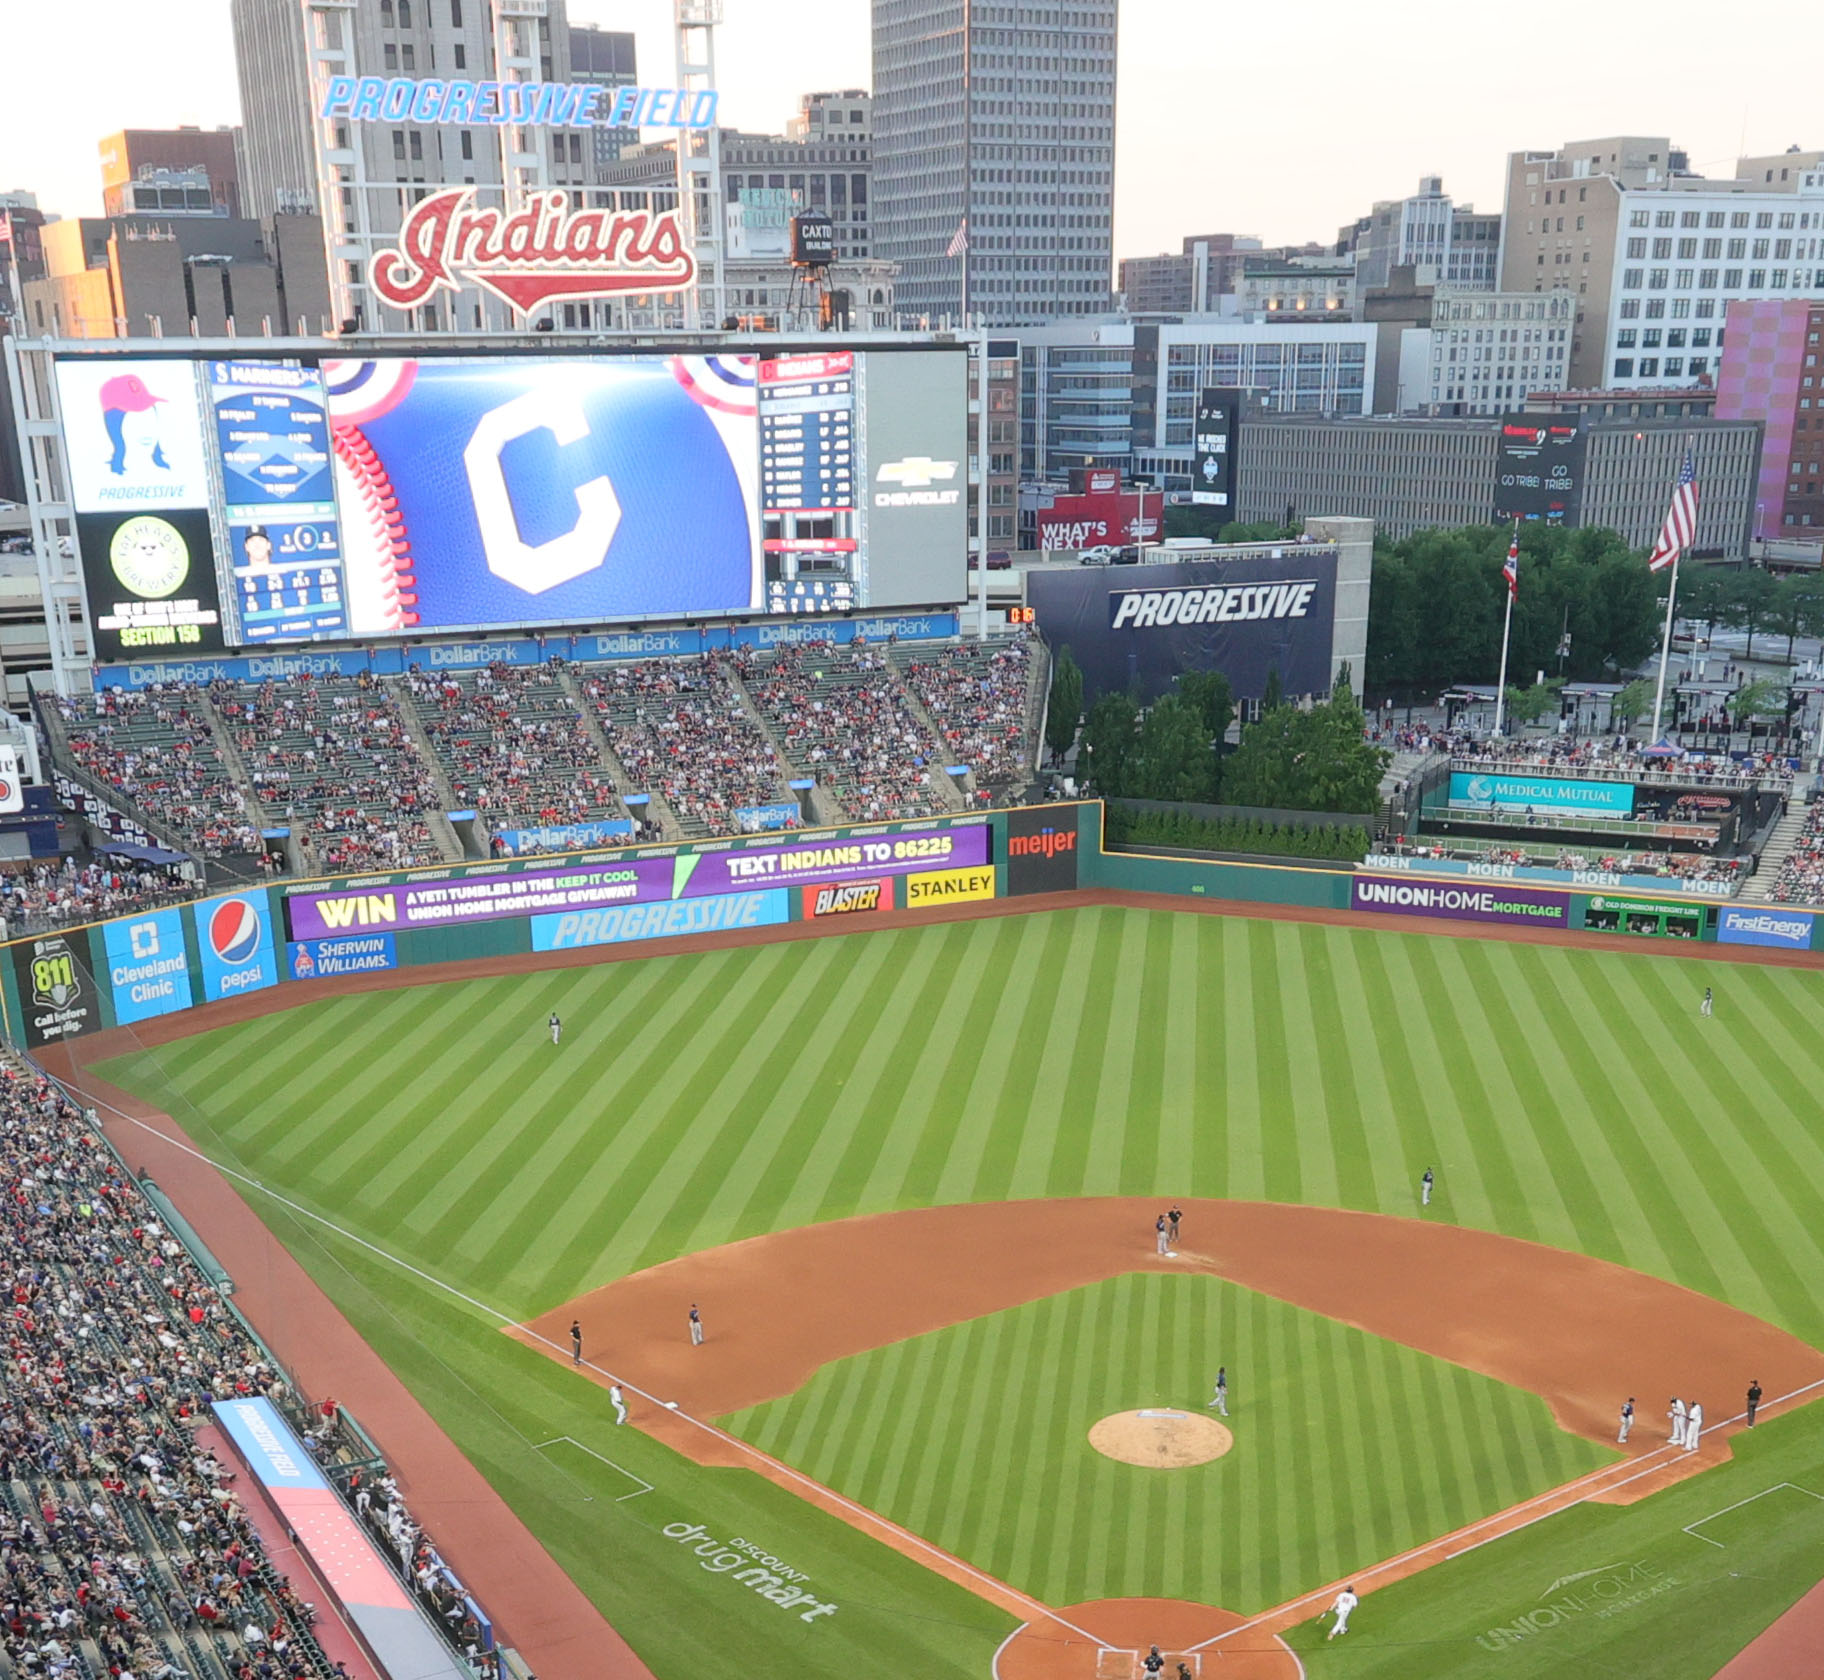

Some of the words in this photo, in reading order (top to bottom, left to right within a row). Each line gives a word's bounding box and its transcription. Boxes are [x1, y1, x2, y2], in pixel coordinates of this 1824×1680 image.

[323, 76, 606, 127] PROGRESSIVE
[607, 86, 719, 128] FIELD
[369, 182, 697, 318] Indians
[98, 484, 186, 500] PROGRESSIVE
[875, 490, 959, 506] CHEVROLET
[1042, 521, 1107, 539] WHAT'S
[1111, 583, 1318, 630] PROGRESSIVE
[120, 625, 176, 646] SECTION
[759, 622, 837, 643] DollarBank
[855, 617, 931, 637] DollarBank
[429, 642, 521, 666] DollarBank
[596, 632, 680, 654] DollarBank
[128, 662, 226, 685] DollarBank
[248, 655, 342, 678] DollarBank
[1494, 783, 1554, 799] MEDICAL
[1557, 786, 1614, 803] MUTUAL
[1008, 828, 1077, 858] meijer
[726, 854, 778, 877] TEXT
[780, 846, 862, 872] INDIANS
[863, 843, 891, 863] TO
[893, 836, 953, 860] 86225
[1365, 854, 1410, 869] MOEN
[1466, 862, 1514, 878] MOEN
[1572, 871, 1621, 886] MOEN
[417, 890, 446, 905] YETI
[447, 883, 511, 902] TUMBLER
[512, 881, 526, 894] IN
[527, 878, 555, 892] THE
[555, 875, 588, 889] KEEP
[589, 873, 601, 885] IT
[603, 870, 638, 884] COOL
[910, 876, 991, 899] STANLEY
[1681, 879, 1732, 894] MOEN
[316, 893, 397, 929] WIN
[407, 904, 453, 920] UNION
[454, 900, 494, 917] HOME
[494, 892, 567, 913] MORTGAGE
[568, 884, 637, 904] GIVEAWAY!
[814, 884, 881, 916] BLASTER
[1492, 901, 1563, 918] MORTGAGE
[1620, 902, 1655, 911] DOMINION
[1655, 904, 1683, 914] FREIGHT
[1684, 907, 1700, 916] LINE
[553, 893, 766, 947] PROGRESSIVE
[1724, 912, 1812, 941] FirstEnergy
[318, 938, 384, 958] SHERWIN
[35, 956, 73, 991] 811
[112, 953, 186, 986] Cleveland
[220, 963, 262, 993] pepsi
[130, 979, 174, 1003] Clinic
[34, 1012, 56, 1028] Call
[56, 1006, 87, 1022] before
[43, 1023, 62, 1040] you
[233, 1404, 285, 1455] PROGRESSIVE
[267, 1452, 301, 1477] FIELD
[728, 1536, 810, 1584] DISCOUNT
[662, 1522, 749, 1572] drug
[732, 1567, 838, 1624] mart
